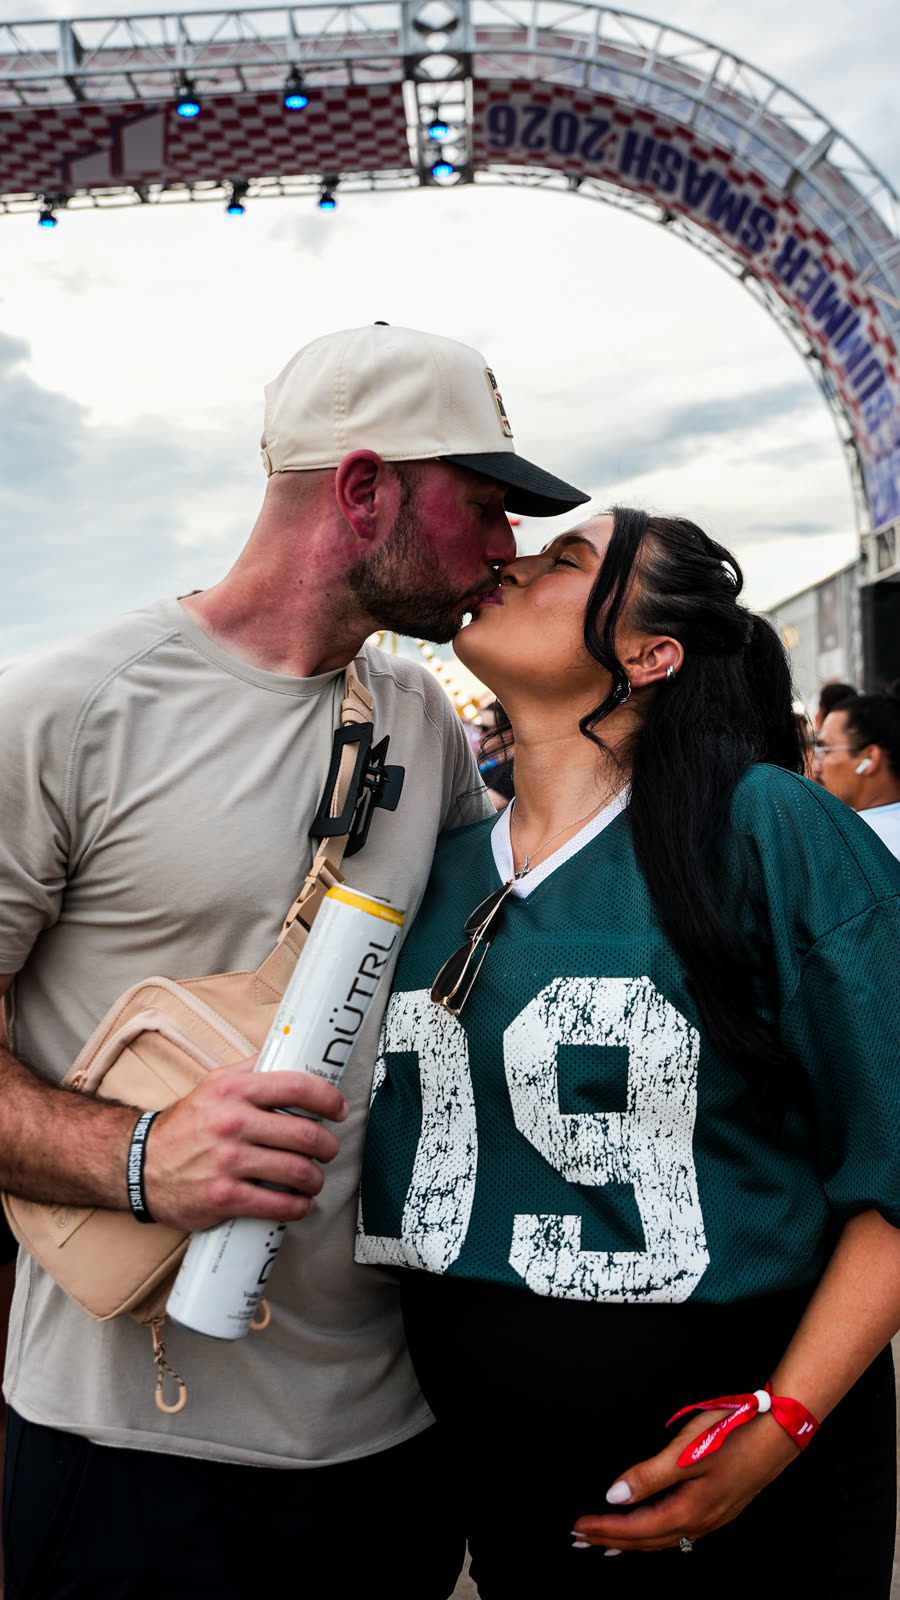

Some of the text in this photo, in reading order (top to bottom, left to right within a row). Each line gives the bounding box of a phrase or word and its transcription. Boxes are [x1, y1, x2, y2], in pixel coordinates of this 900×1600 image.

[487, 103, 896, 434] SUMMER SMASH 2026
[128, 1143, 142, 1184] MISSION
[691, 1427, 720, 1461] Golden
